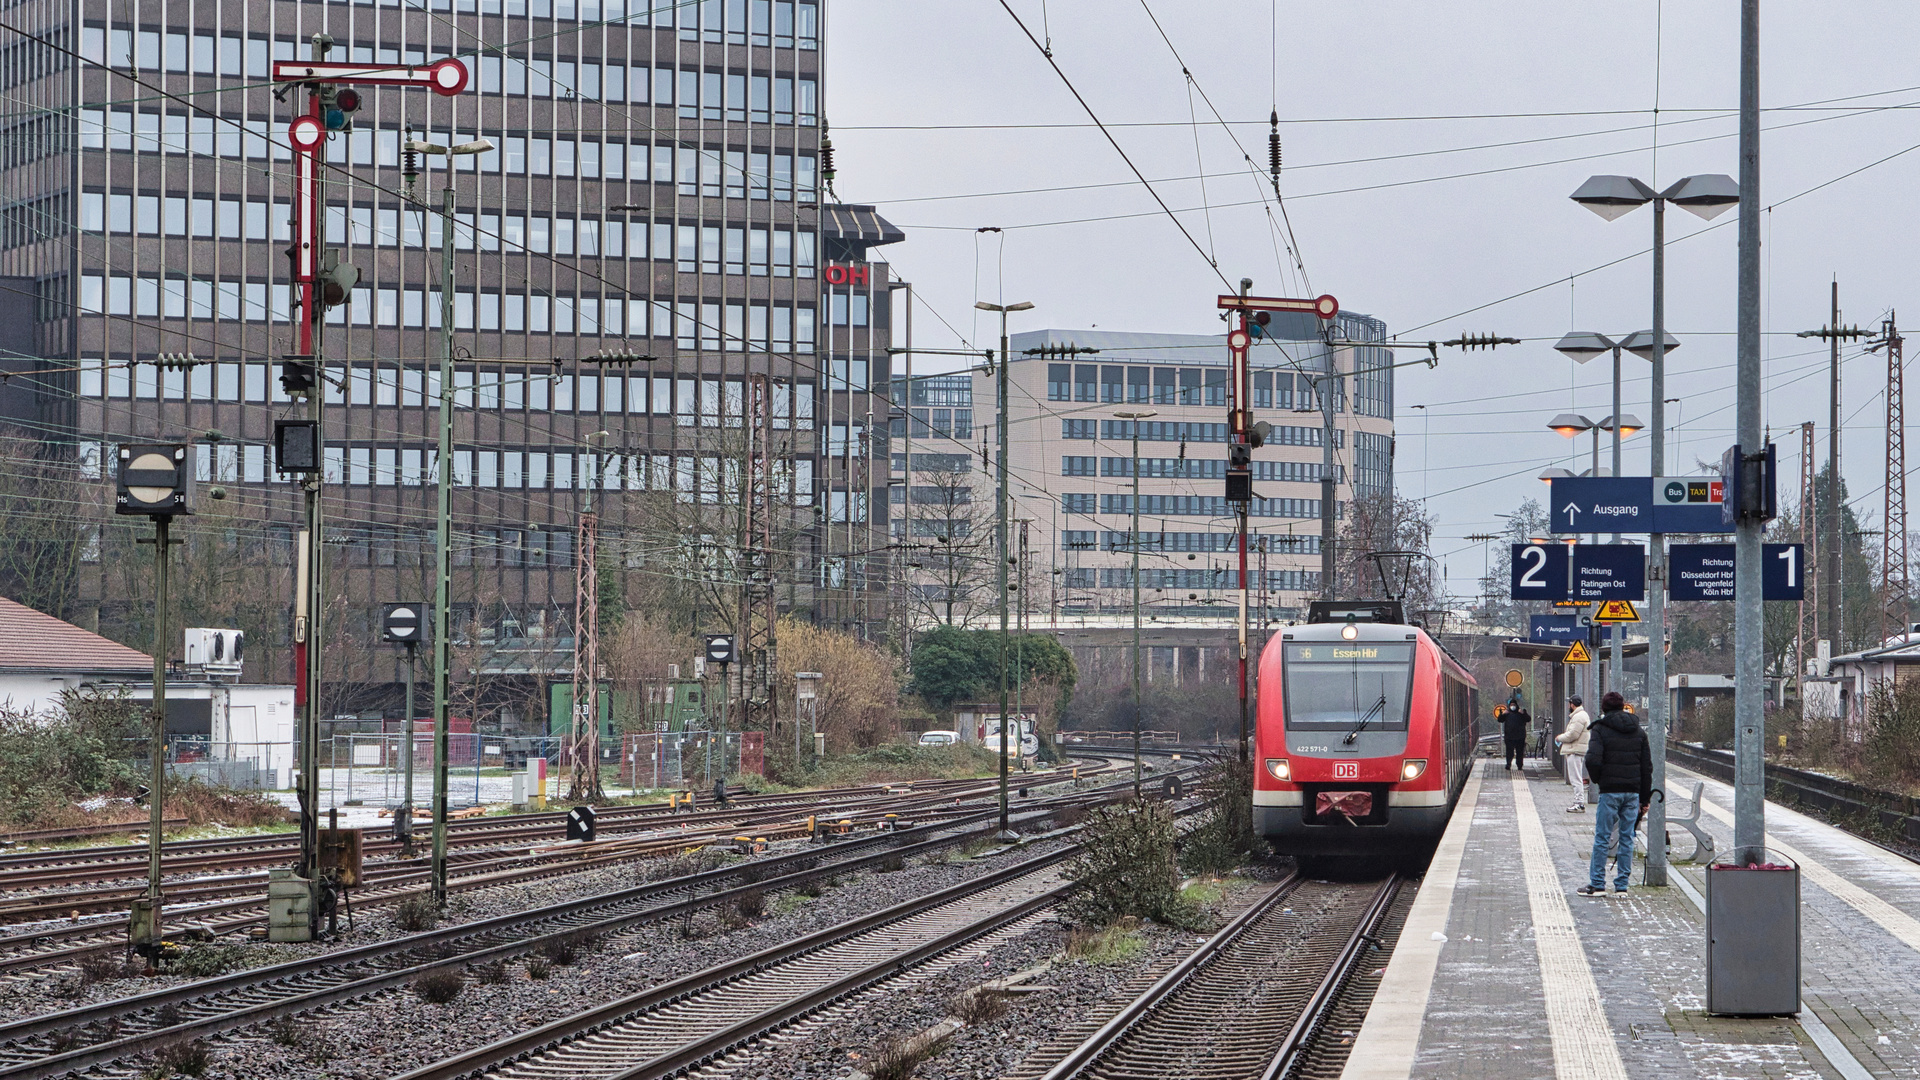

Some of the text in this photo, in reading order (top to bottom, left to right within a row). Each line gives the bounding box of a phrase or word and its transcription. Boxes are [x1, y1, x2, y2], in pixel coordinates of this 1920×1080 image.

[824, 265, 868, 286] OH
[1668, 488, 1682, 496] Bus
[1689, 488, 1706, 496] TAXI
[1712, 488, 1722, 496] Tra
[117, 495, 128, 503] Hs
[1593, 504, 1639, 516] Ausgang
[1519, 546, 1547, 588] 2
[1702, 558, 1734, 568] Richtung
[1778, 546, 1797, 588] 1
[1581, 567, 1612, 576] Richtung
[1681, 571, 1734, 579] Düsseldorf Hbf
[1580, 579, 1626, 589] Ratingen Ost
[1694, 579, 1734, 588] Langenfeld
[1580, 588, 1602, 596] Essen
[1702, 588, 1734, 596] Köln Hbf
[1333, 648, 1361, 658] Essen
[1362, 648, 1378, 658] Hbf
[1335, 764, 1357, 777] DB
